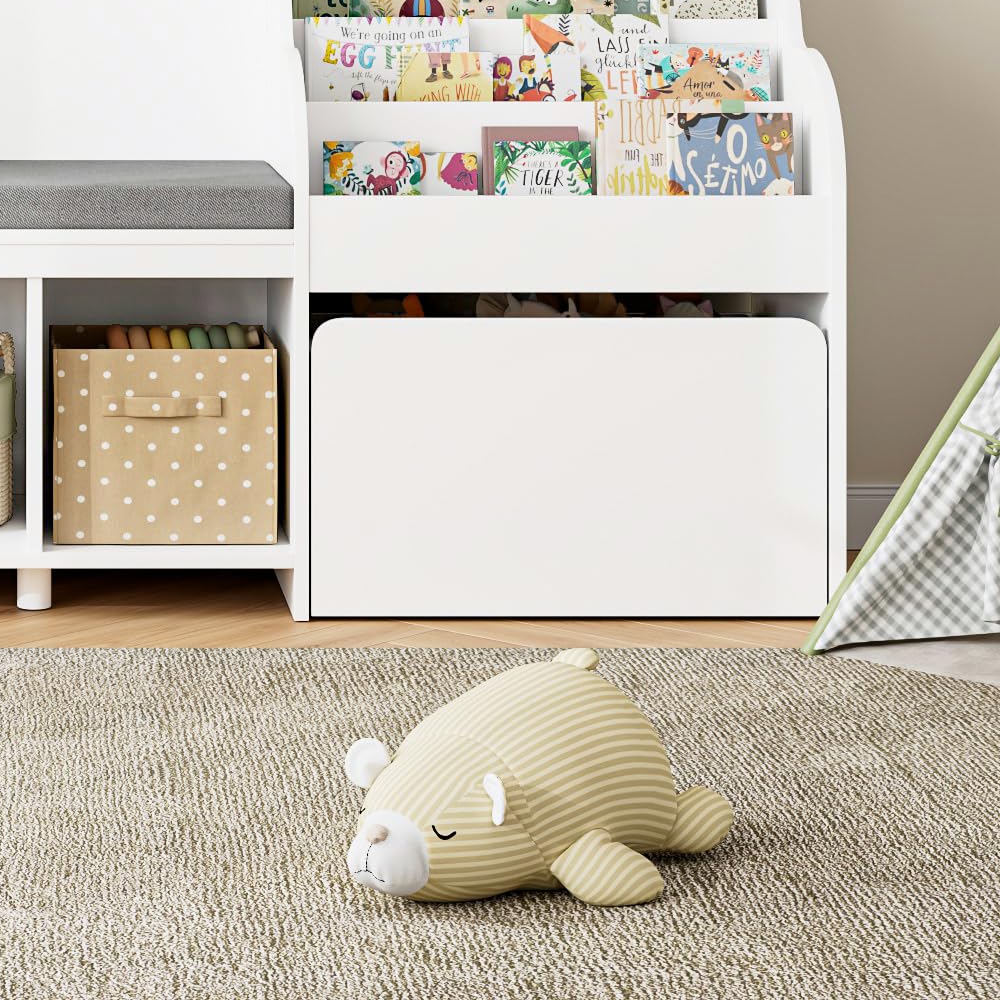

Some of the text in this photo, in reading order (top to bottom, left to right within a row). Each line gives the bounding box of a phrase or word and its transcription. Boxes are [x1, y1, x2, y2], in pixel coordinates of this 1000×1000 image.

[340, 26, 442, 43] We're going on an
[621, 23, 650, 34] und
[597, 36, 630, 53] LASS
[323, 39, 377, 70] EGG
[455, 82, 482, 101] WITH
[683, 77, 715, 93] Amor
[726, 123, 748, 165] O
[519, 168, 564, 187] TIGER
[540, 187, 552, 195] THE
